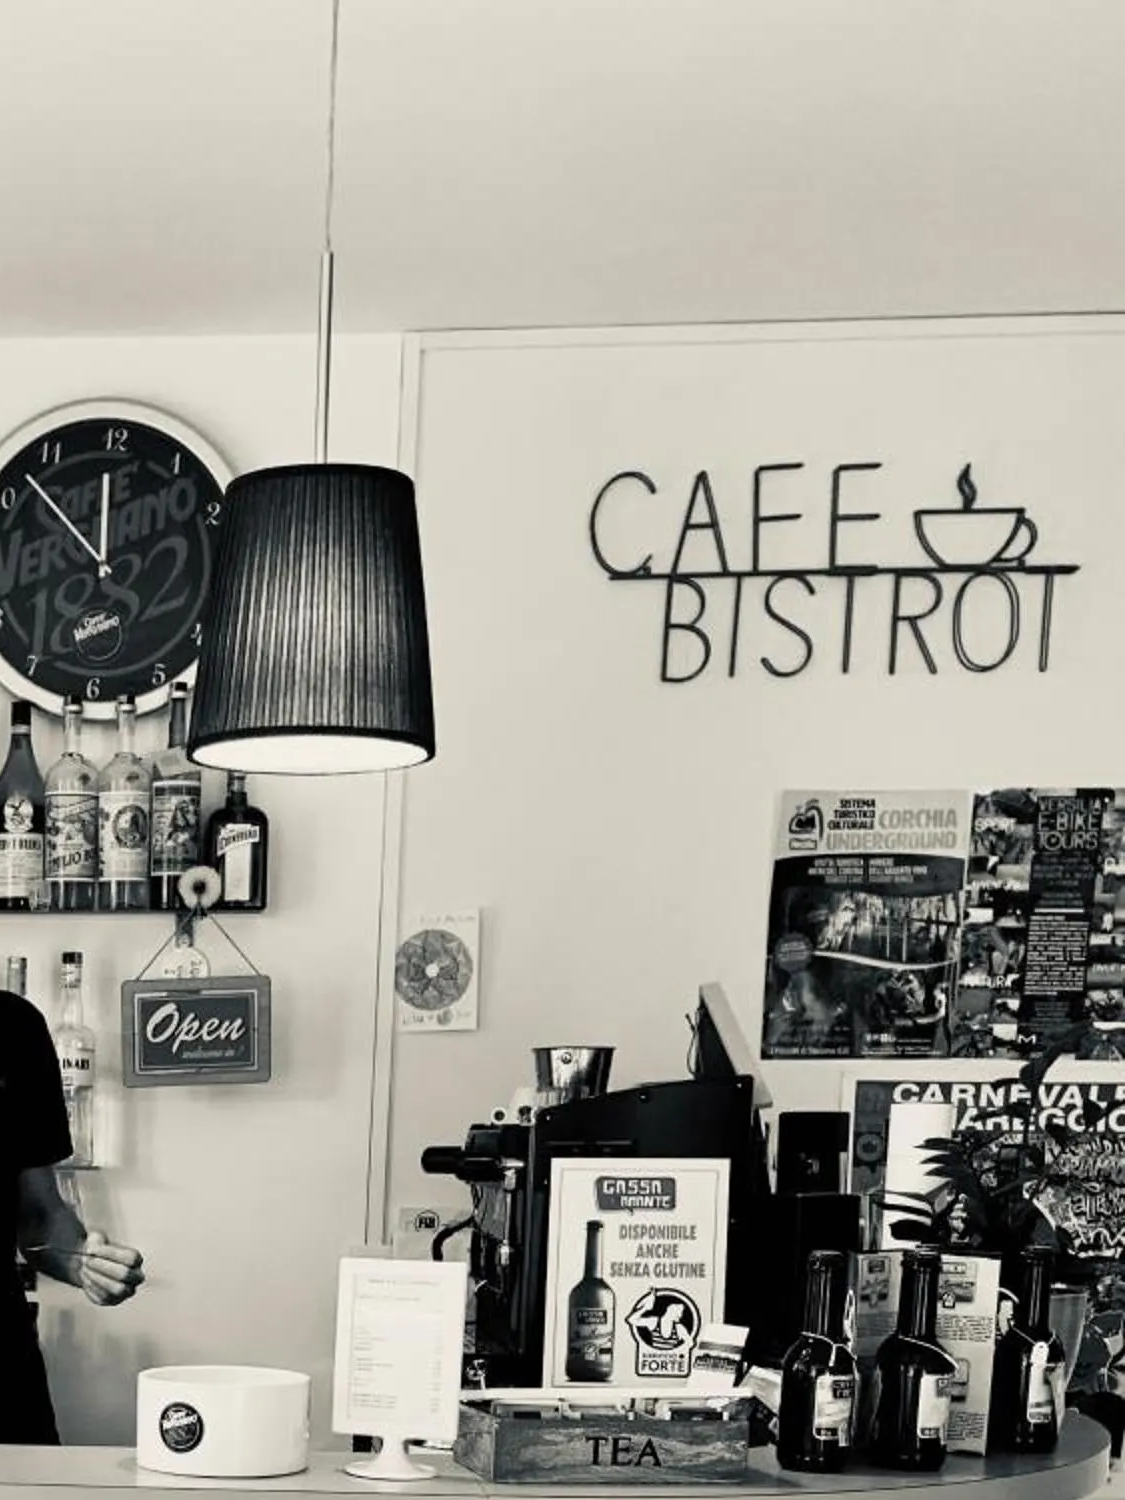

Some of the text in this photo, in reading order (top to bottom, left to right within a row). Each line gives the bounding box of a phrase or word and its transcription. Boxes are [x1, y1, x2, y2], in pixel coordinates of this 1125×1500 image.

[105, 428, 129, 451] 12
[41, 442, 62, 465] 11
[174, 451, 182, 475] 1
[206, 502, 222, 526] 2
[590, 463, 882, 576] CAFE
[28, 536, 190, 658] 1882
[661, 565, 1080, 682] BISTROT
[26, 655, 39, 678] 7
[152, 664, 167, 686] 5
[86, 677, 100, 699] 6
[834, 810, 875, 819] TURISTICO
[840, 799, 875, 809] SISTEMA
[827, 820, 874, 830] CULTURALE
[878, 809, 957, 829] CORCHIA
[1038, 812, 1099, 831] E-BIKE
[826, 831, 957, 850] UNDERGROUND
[1037, 831, 1099, 850] TOURS
[146, 1002, 246, 1054] Open
[619, 1225, 697, 1240] DISPONIBILE
[635, 1244, 679, 1259] ANCHE
[610, 1262, 706, 1279] SENZA GLUTINE
[641, 1360, 686, 1373] FORTE
[586, 1436, 662, 1467] TEA
